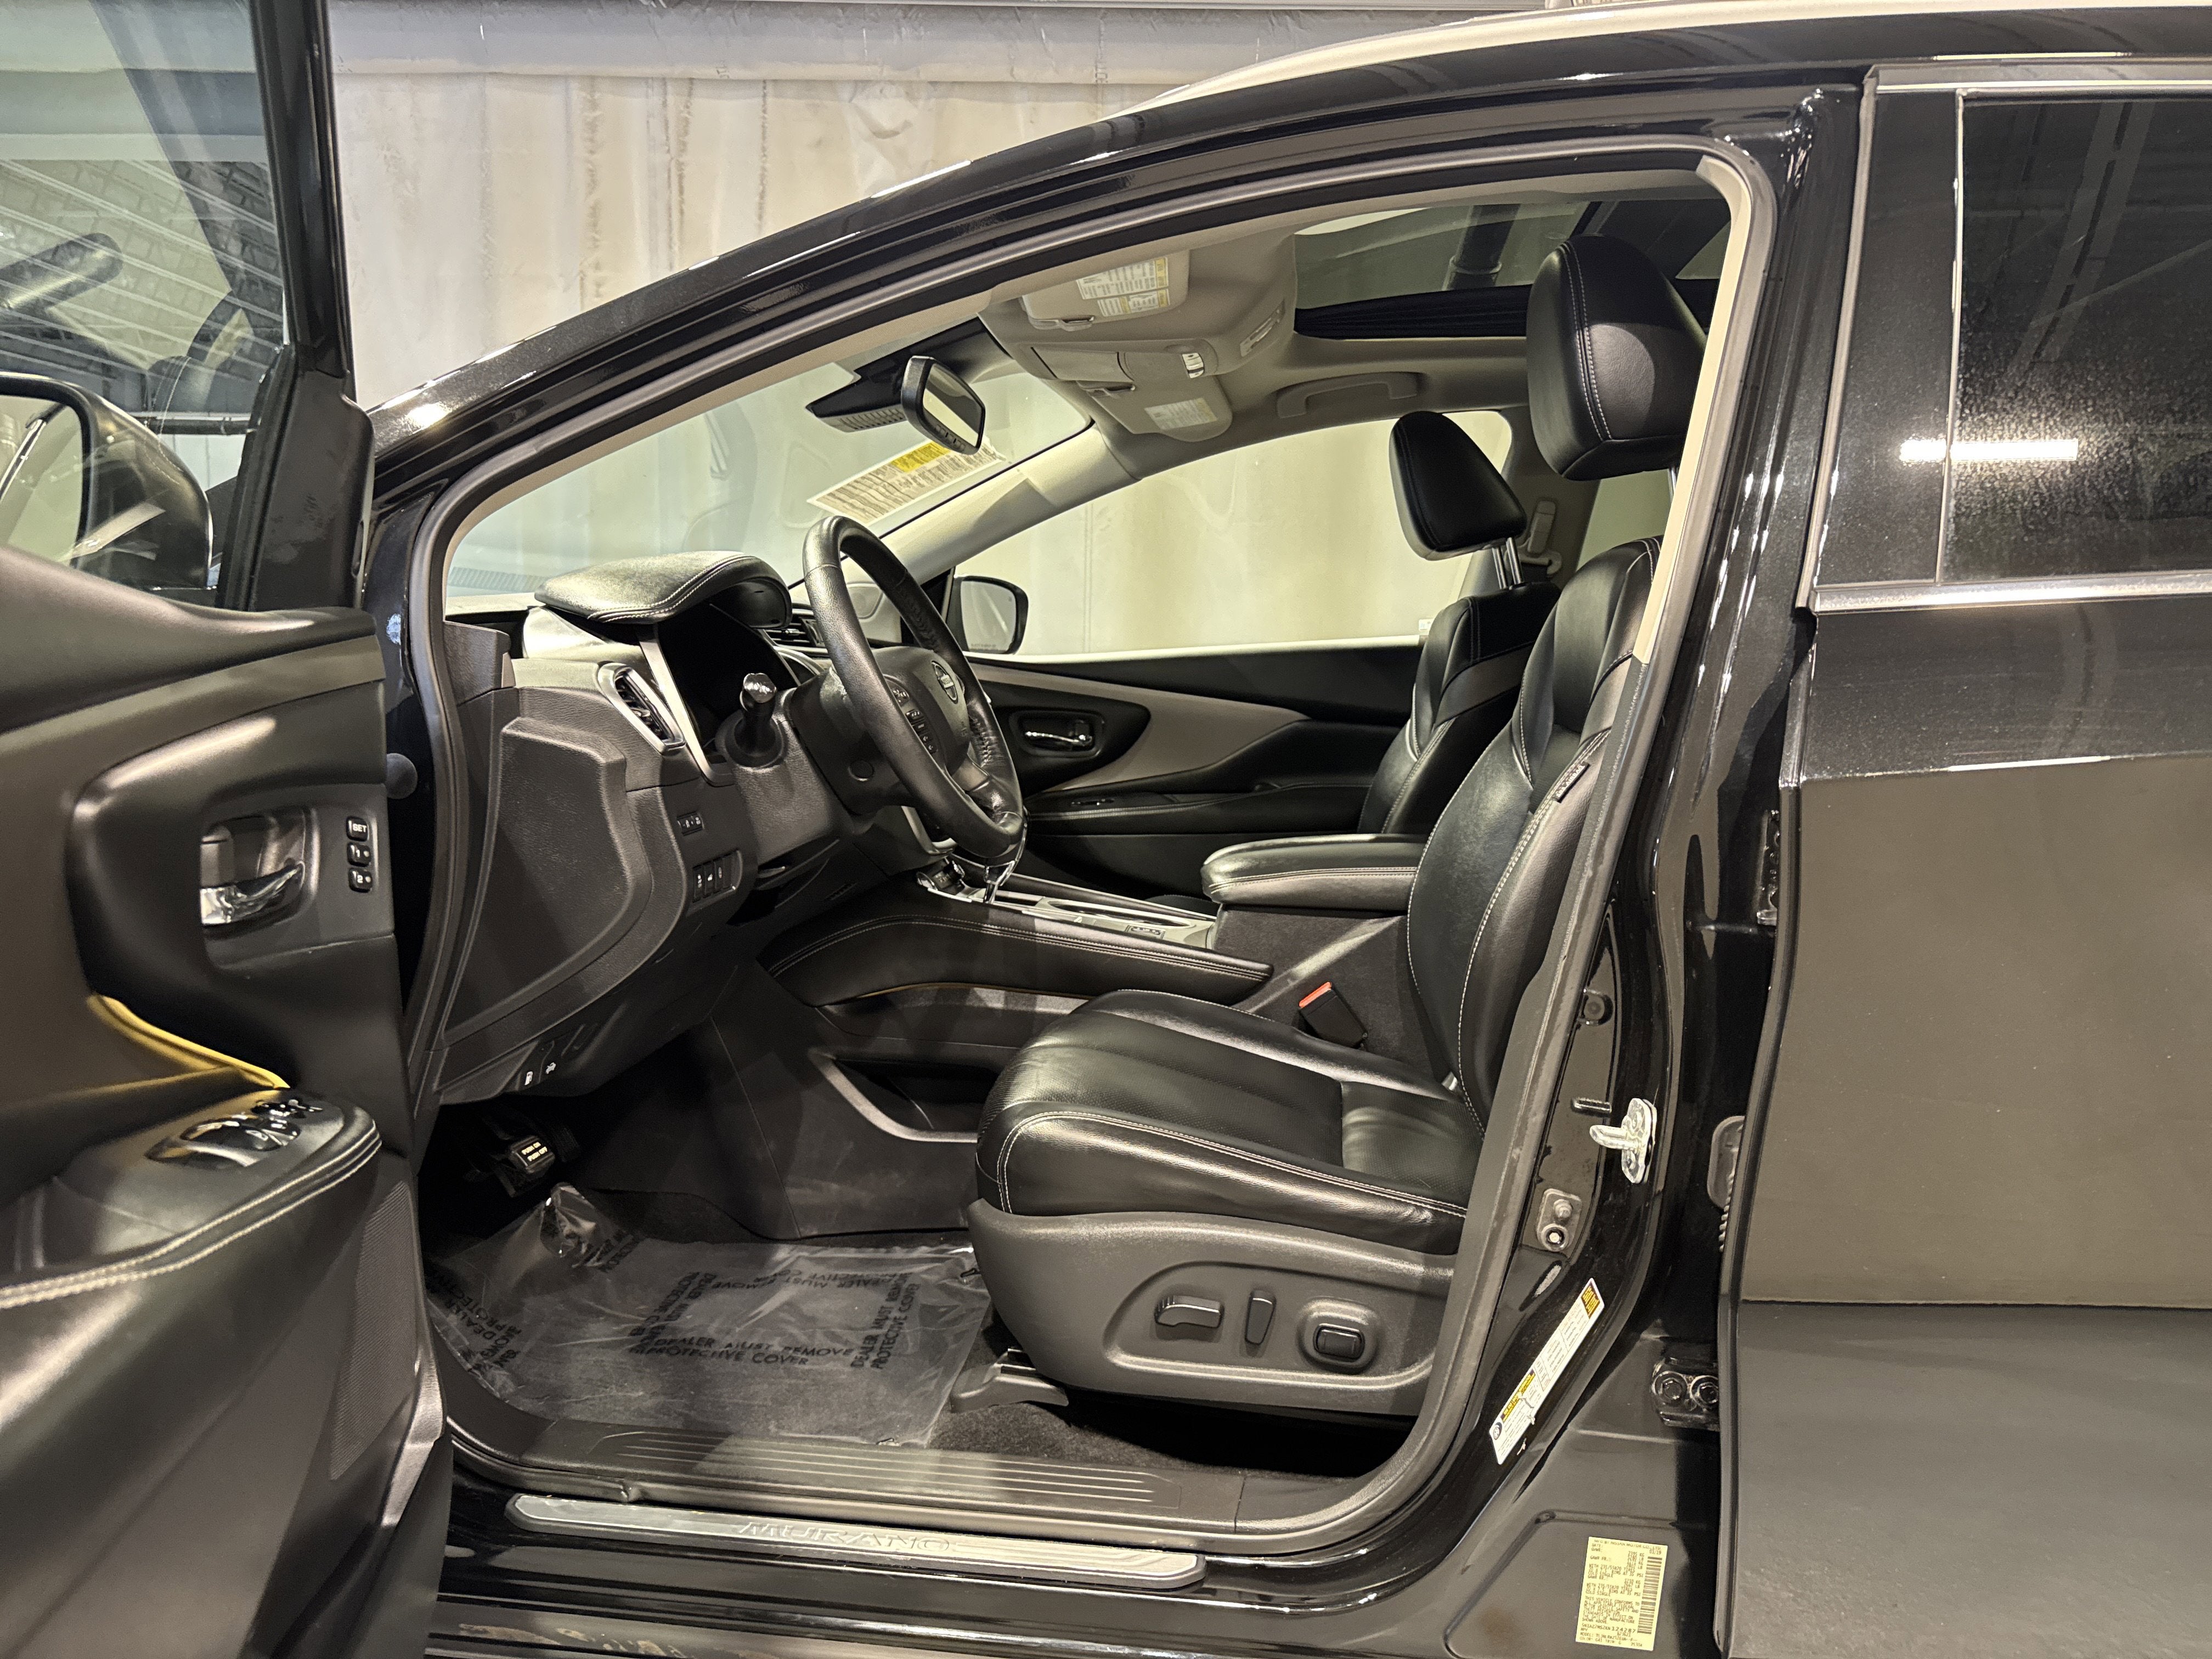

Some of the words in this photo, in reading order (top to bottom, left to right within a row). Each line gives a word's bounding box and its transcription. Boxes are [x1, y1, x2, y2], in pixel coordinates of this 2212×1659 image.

[353, 823, 367, 832] SET
[752, 1352, 809, 1365] COVER
[740, 1521, 950, 1552] MURANO
